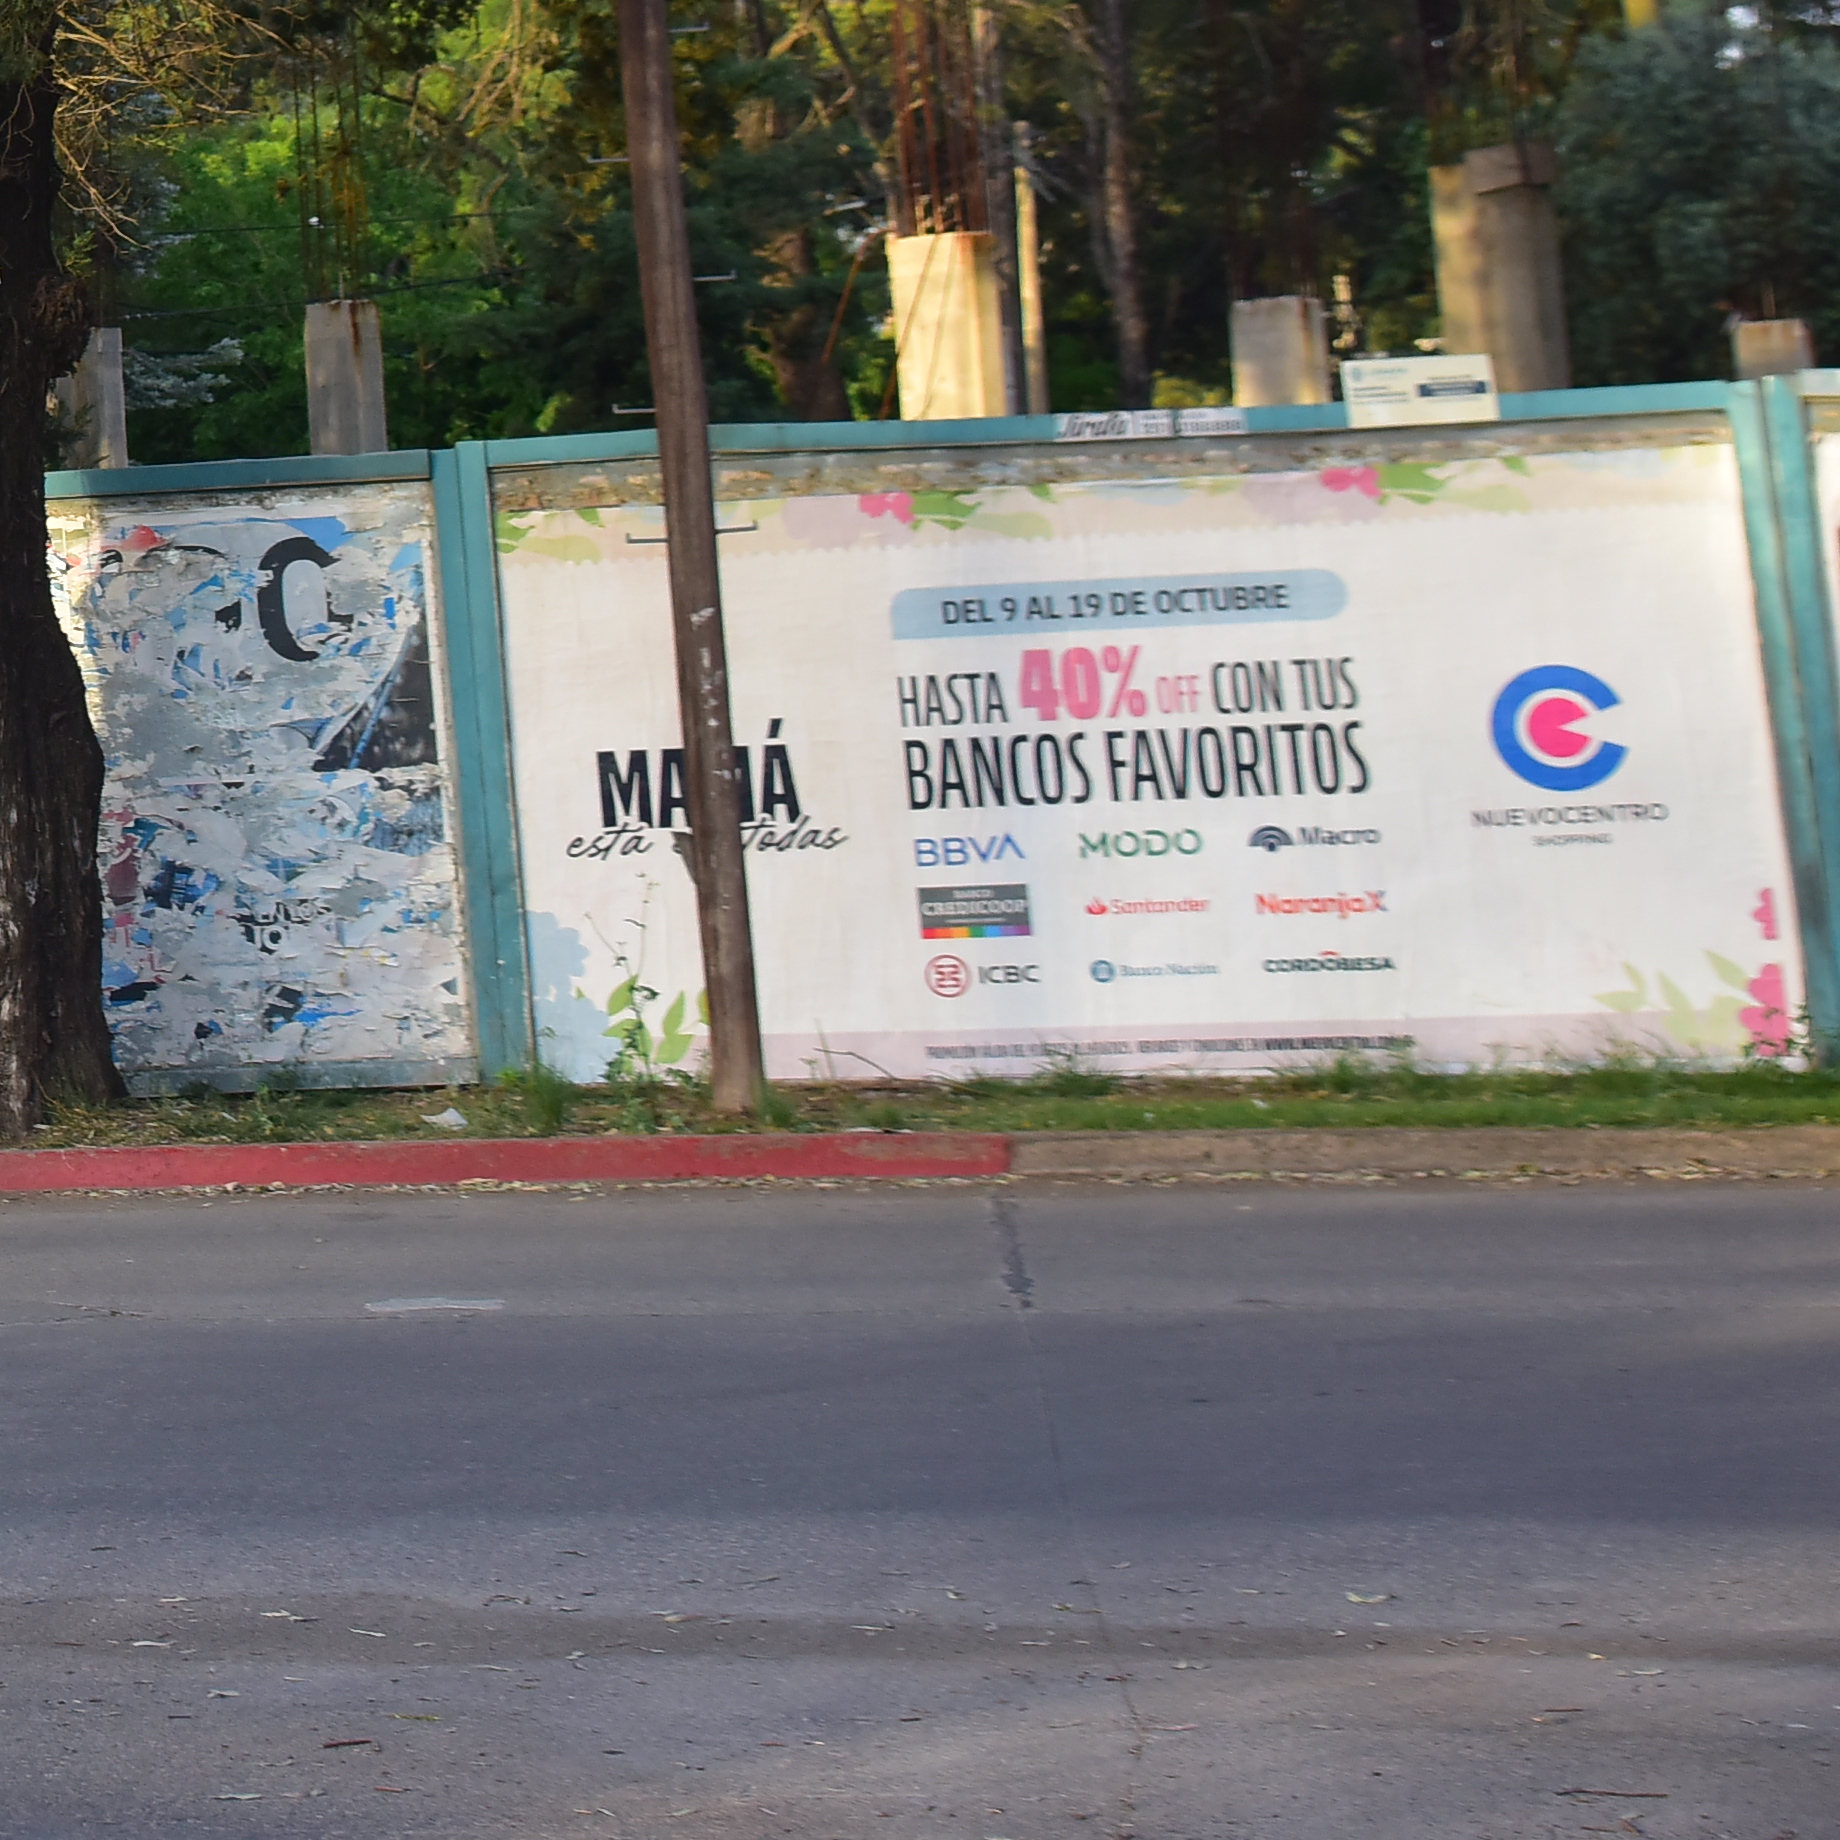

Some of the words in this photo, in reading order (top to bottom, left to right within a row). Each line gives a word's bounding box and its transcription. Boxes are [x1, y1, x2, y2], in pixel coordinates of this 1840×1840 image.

[942, 598, 994, 626] DEL
[1002, 597, 1017, 622] 9
[1025, 596, 1063, 621] AL
[1071, 593, 1102, 618] 19
[1109, 590, 1148, 617] DE
[1157, 584, 1292, 615] OCTUBRE
[896, 671, 1009, 728] HASTA
[1019, 644, 1148, 723] 40%
[1155, 674, 1201, 715] OFF
[1210, 660, 1284, 715] CON
[1292, 656, 1359, 712] TUS
[596, 718, 801, 828] MAÁ
[901, 731, 1094, 811] BANCOS
[1105, 720, 1372, 803] FAVORITOS
[1470, 802, 1670, 827] NUEVOCENTRO
[741, 814, 849, 852] todas
[1078, 828, 1204, 859] MODO
[1297, 825, 1382, 846] Macro
[914, 832, 1026, 868] BBVA
[921, 899, 1026, 916] CREDICOOP
[1110, 897, 1211, 915] Santander
[979, 963, 1041, 985] ICBC
[1120, 964, 1163, 977] Banco
